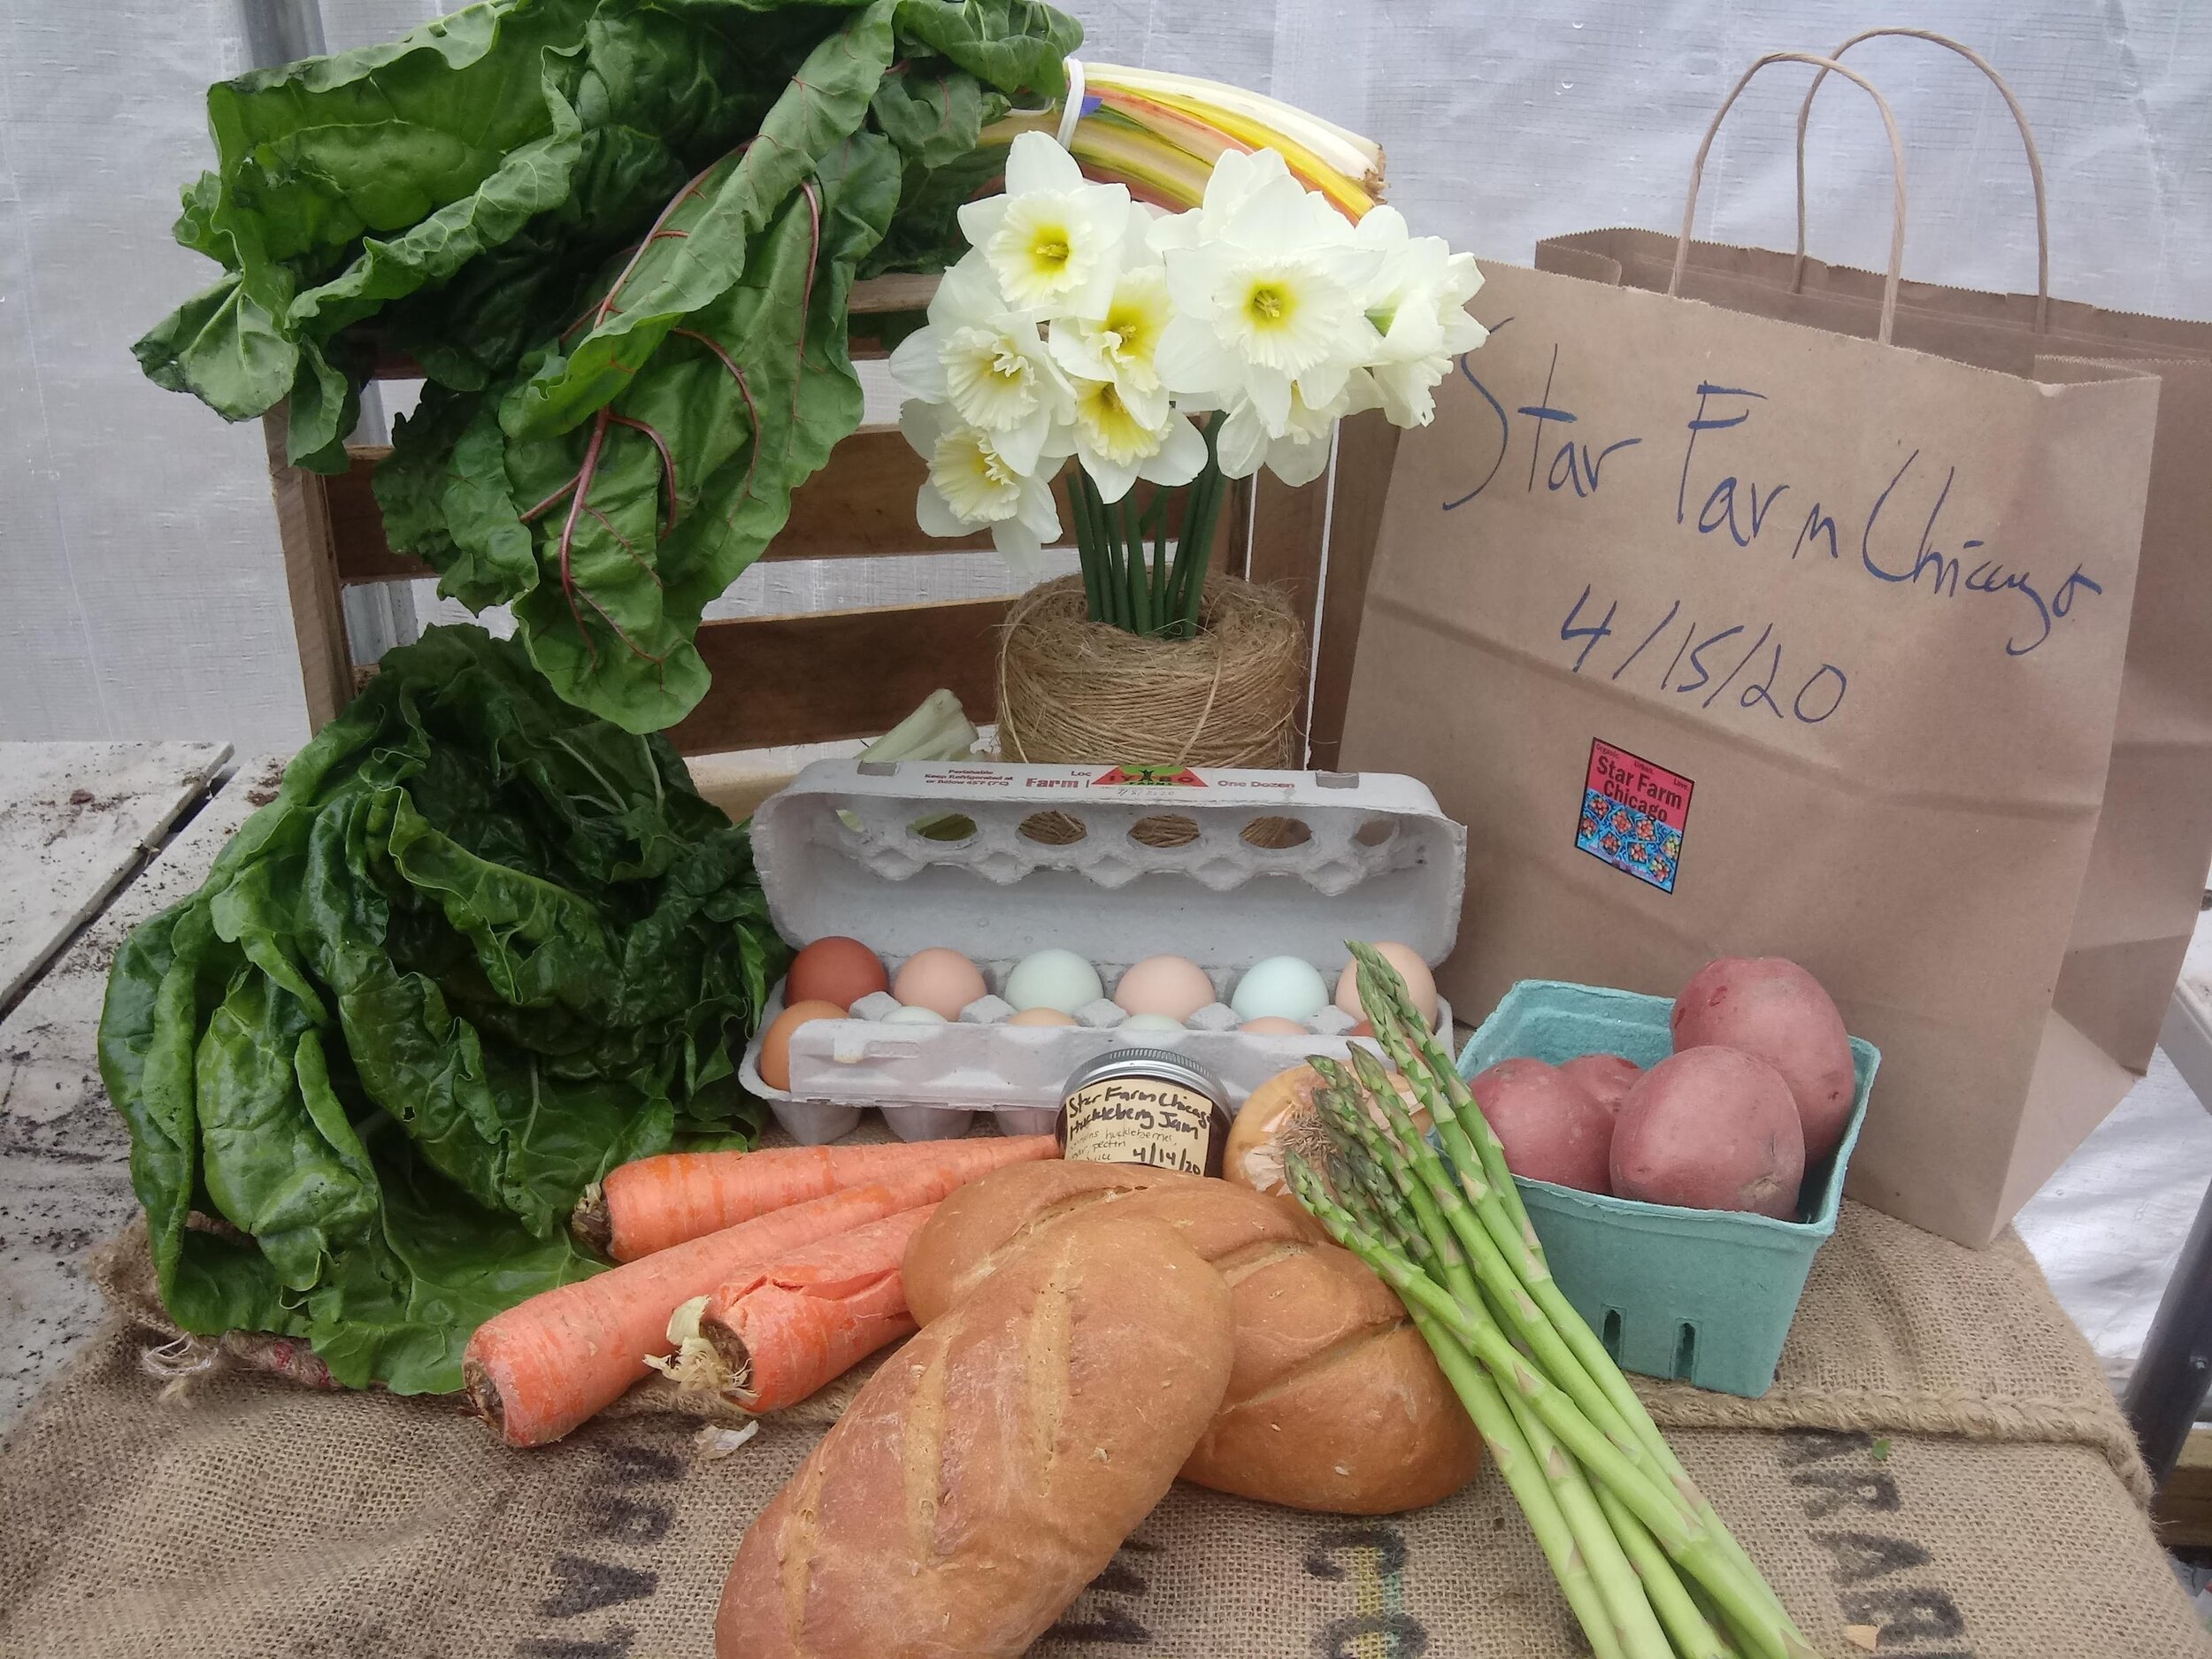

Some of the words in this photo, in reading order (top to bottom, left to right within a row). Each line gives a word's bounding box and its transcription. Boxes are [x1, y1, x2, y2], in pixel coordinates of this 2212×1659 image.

[1442, 317, 1643, 511] Star
[1677, 380, 1839, 560] Farm
[1560, 583, 1847, 724] 4/15/20
[1025, 778, 1079, 788] Farm
[1596, 755, 1634, 787] Star
[1637, 773, 1683, 810] Farm
[1604, 780, 1668, 823] Chicago
[1069, 1093, 1102, 1118] Star
[1104, 1086, 1156, 1102] Farm
[1157, 1110, 1199, 1140] Jam
[1133, 1142, 1201, 1175] 4/14/20
